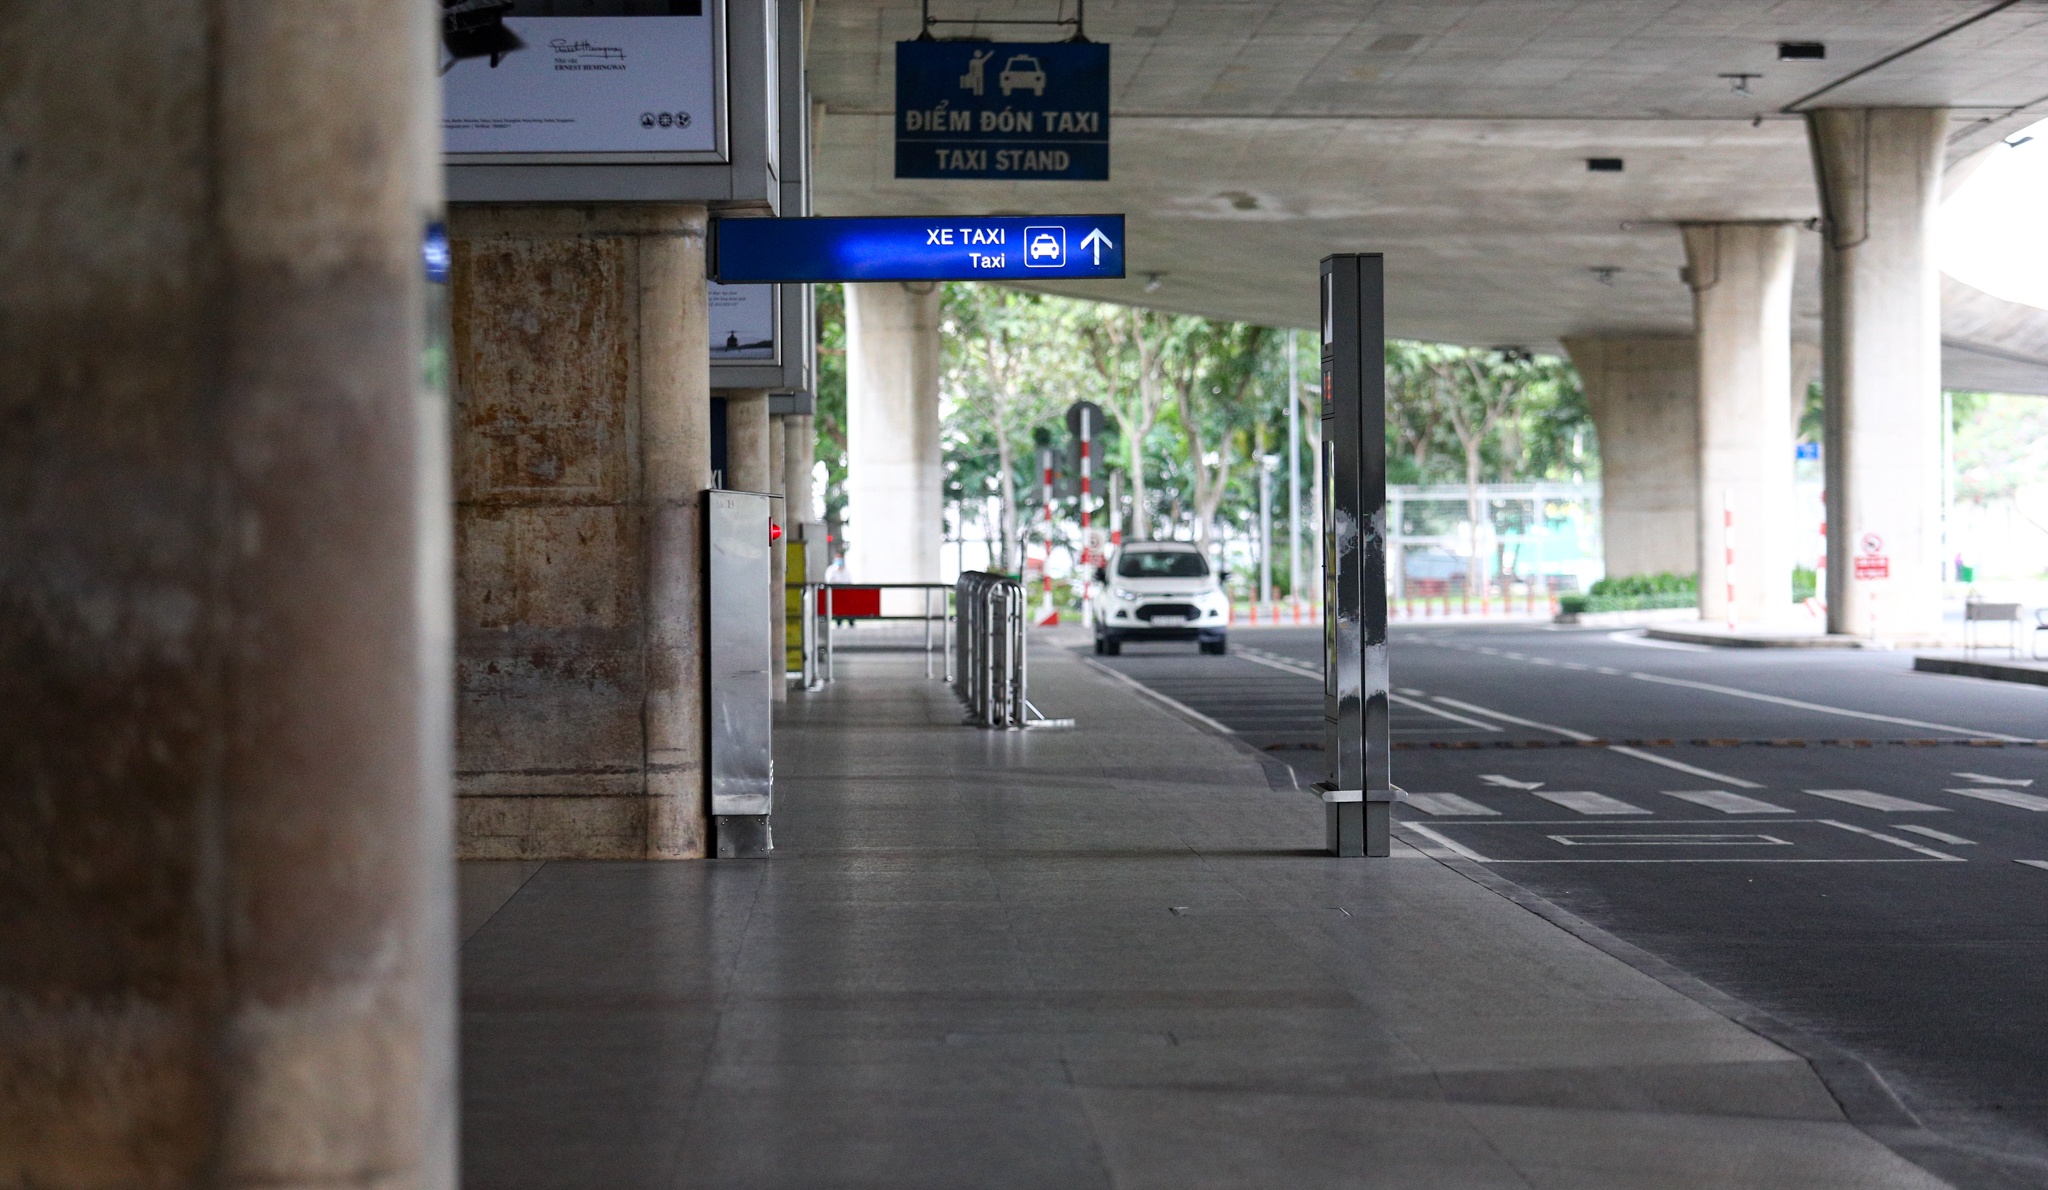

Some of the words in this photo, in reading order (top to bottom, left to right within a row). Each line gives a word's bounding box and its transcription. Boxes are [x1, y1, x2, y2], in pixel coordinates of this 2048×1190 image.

[905, 99, 971, 132] ĐIỂM
[979, 106, 1034, 133] ĐÓN
[1042, 111, 1099, 133] TAXI
[935, 149, 988, 170] TAXI
[995, 150, 1070, 171] STAND
[926, 229, 954, 245] XE
[959, 228, 1006, 245] TAXI
[969, 253, 1006, 268] Taxi
